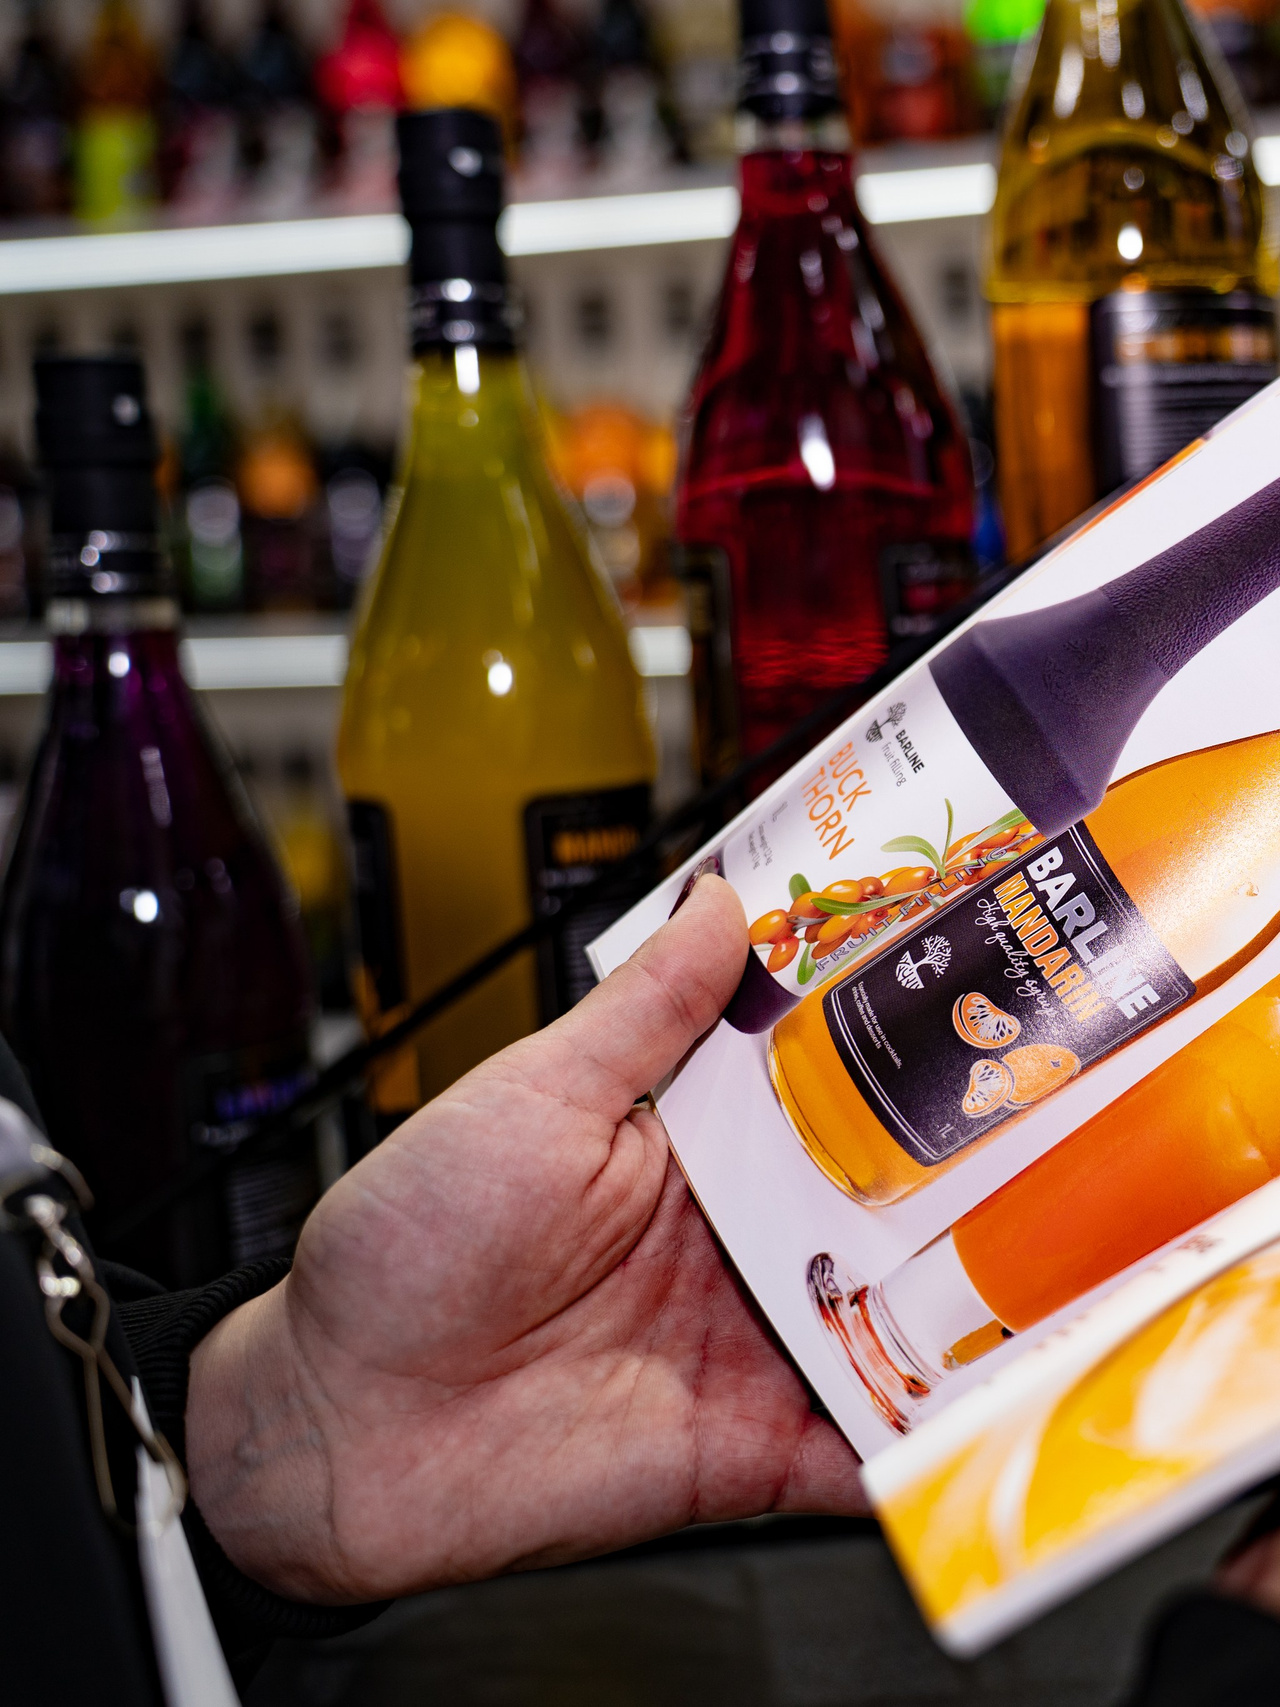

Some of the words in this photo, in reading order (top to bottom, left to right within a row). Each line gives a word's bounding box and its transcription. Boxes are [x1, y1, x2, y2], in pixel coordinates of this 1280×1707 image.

[828, 741, 872, 813] BUCK
[881, 742, 897, 763] fruit
[890, 758, 907, 788] filling
[895, 729, 925, 774] BARLINE
[801, 765, 855, 861] THORN
[815, 914, 893, 972] FRUIT
[899, 846, 1008, 917] FILLING
[975, 898, 1011, 932] High
[1026, 846, 1161, 1020] BARLINE
[985, 930, 1030, 979] quality
[993, 870, 1107, 1023] MANDARIN
[1016, 979, 1056, 1017] syrup
[865, 1002, 875, 1018] made
[874, 1024, 884, 1036] use
[884, 1040, 903, 1070] cocktails,
[866, 1024, 882, 1050] desserts
